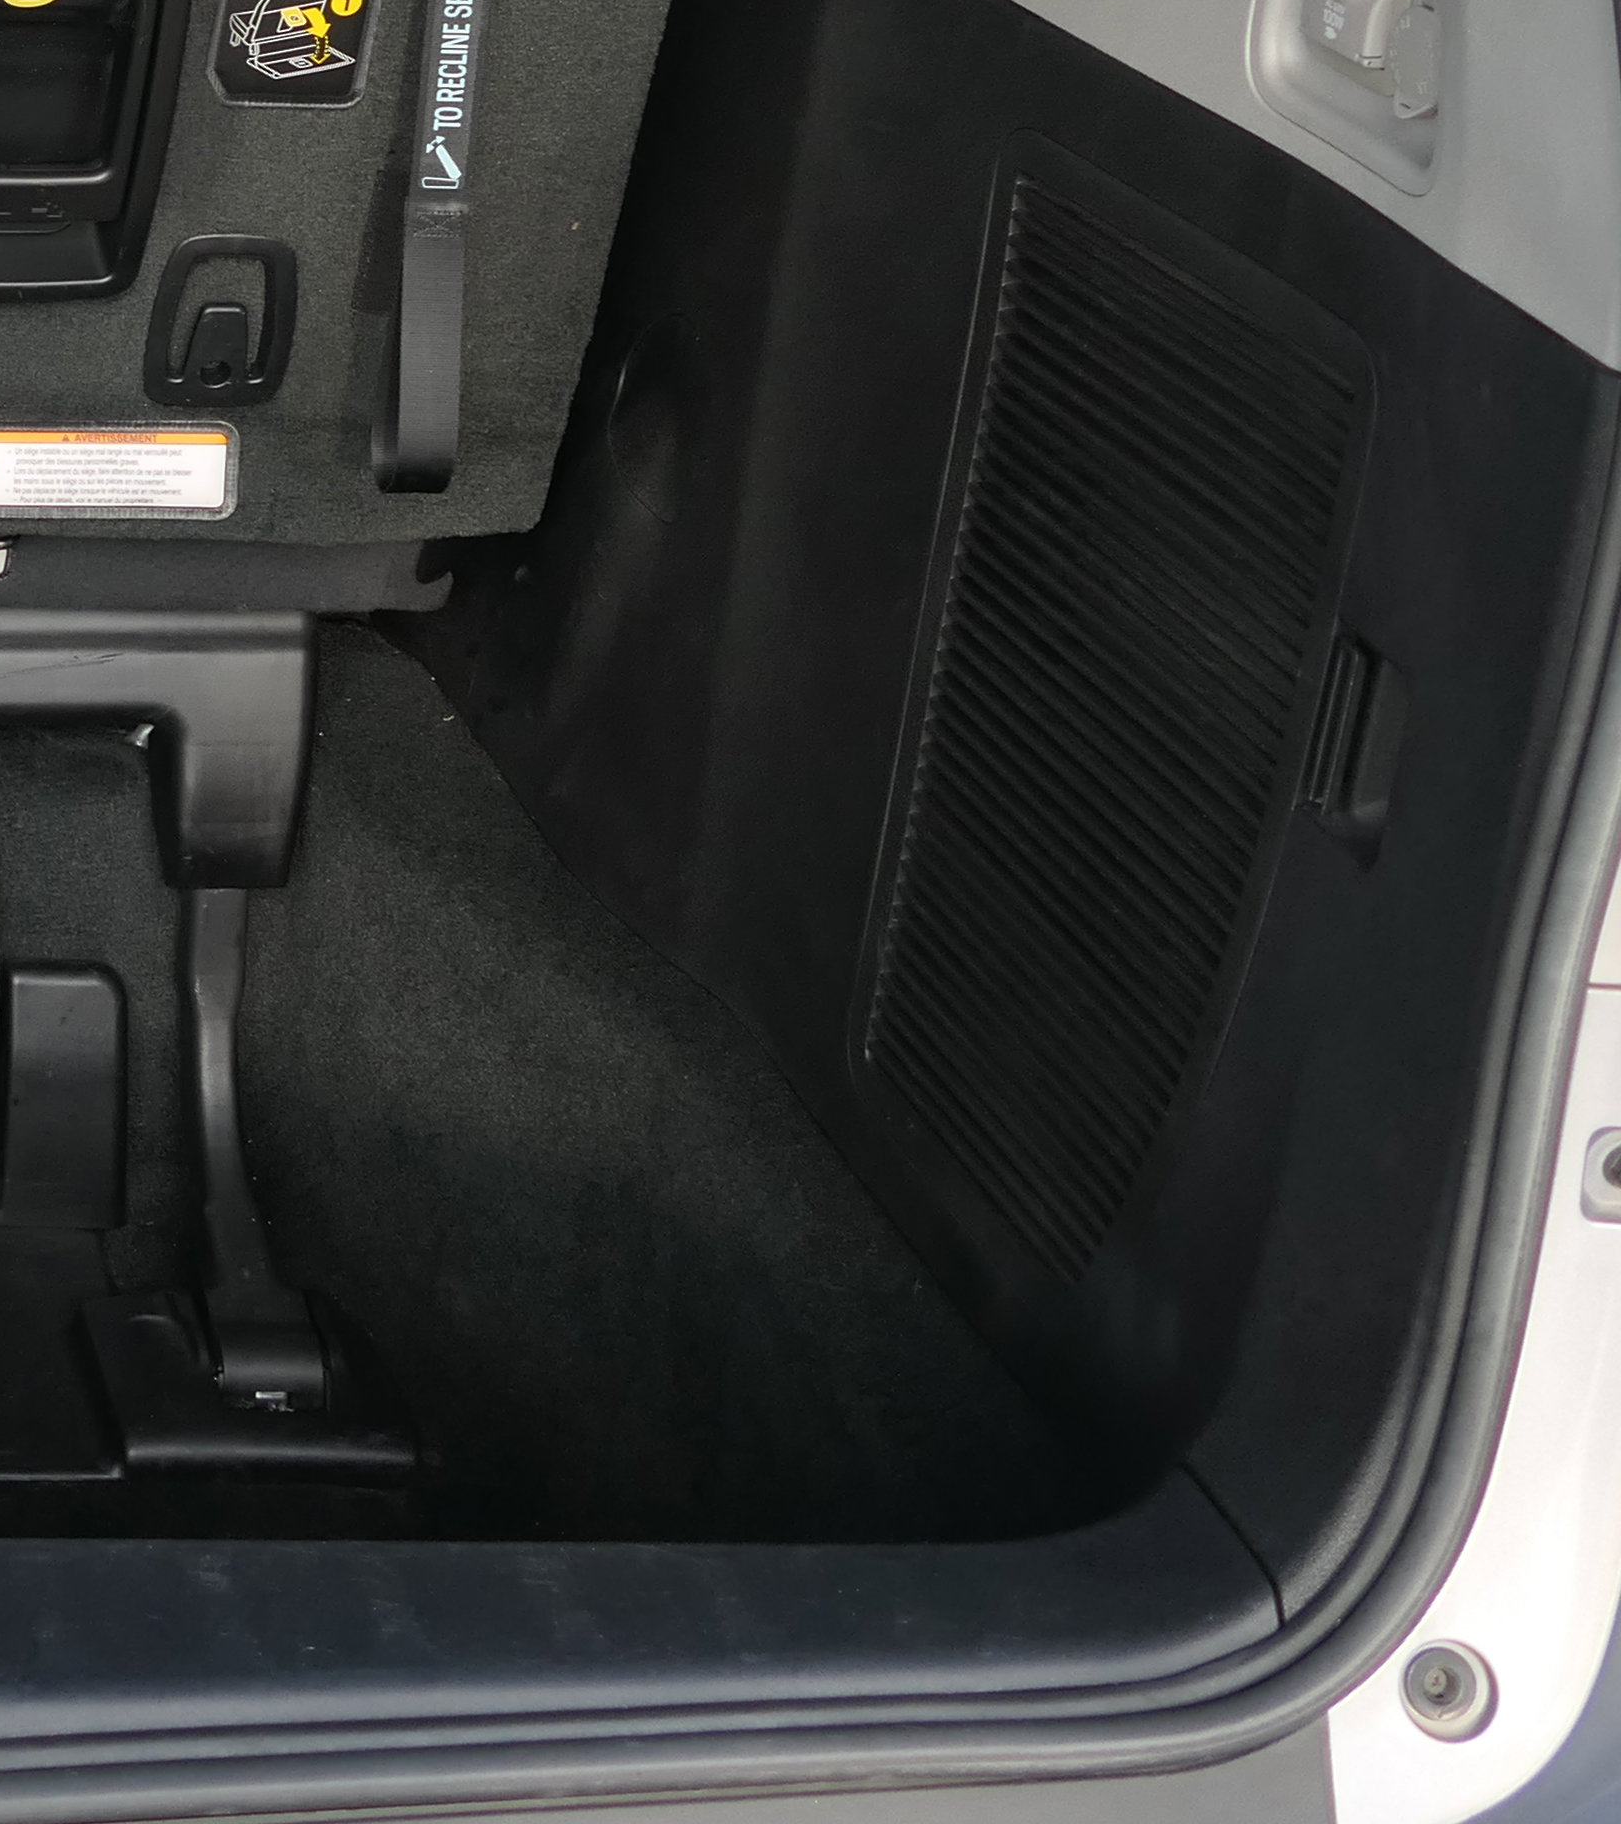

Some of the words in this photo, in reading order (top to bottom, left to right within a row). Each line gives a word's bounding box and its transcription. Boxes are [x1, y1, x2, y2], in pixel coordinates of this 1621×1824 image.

[436, 23, 471, 103] RECLINE
[433, 106, 463, 131] TO
[74, 434, 157, 443] AVERTISSEMENT
